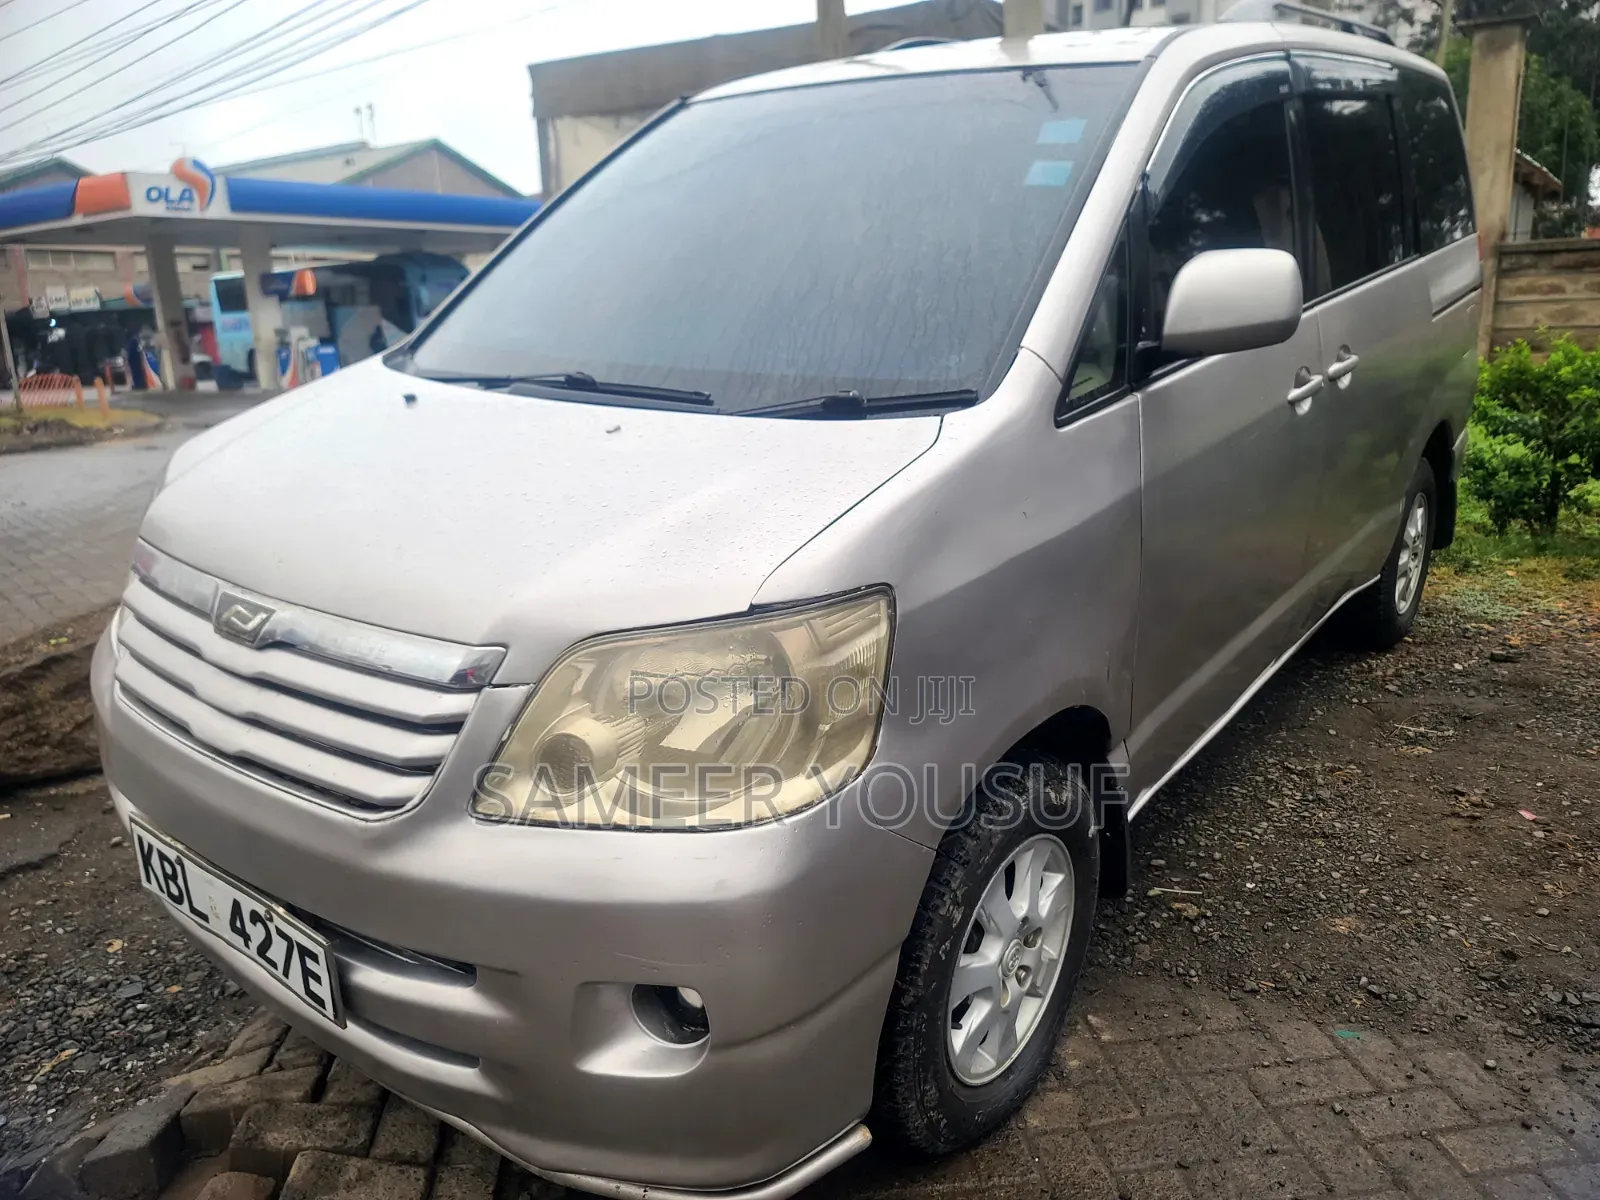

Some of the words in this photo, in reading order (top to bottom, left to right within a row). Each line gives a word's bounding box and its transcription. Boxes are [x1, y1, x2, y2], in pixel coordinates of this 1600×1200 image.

[146, 186, 195, 203] OLA
[137, 833, 210, 924] KBL
[229, 898, 327, 1011] 427E
